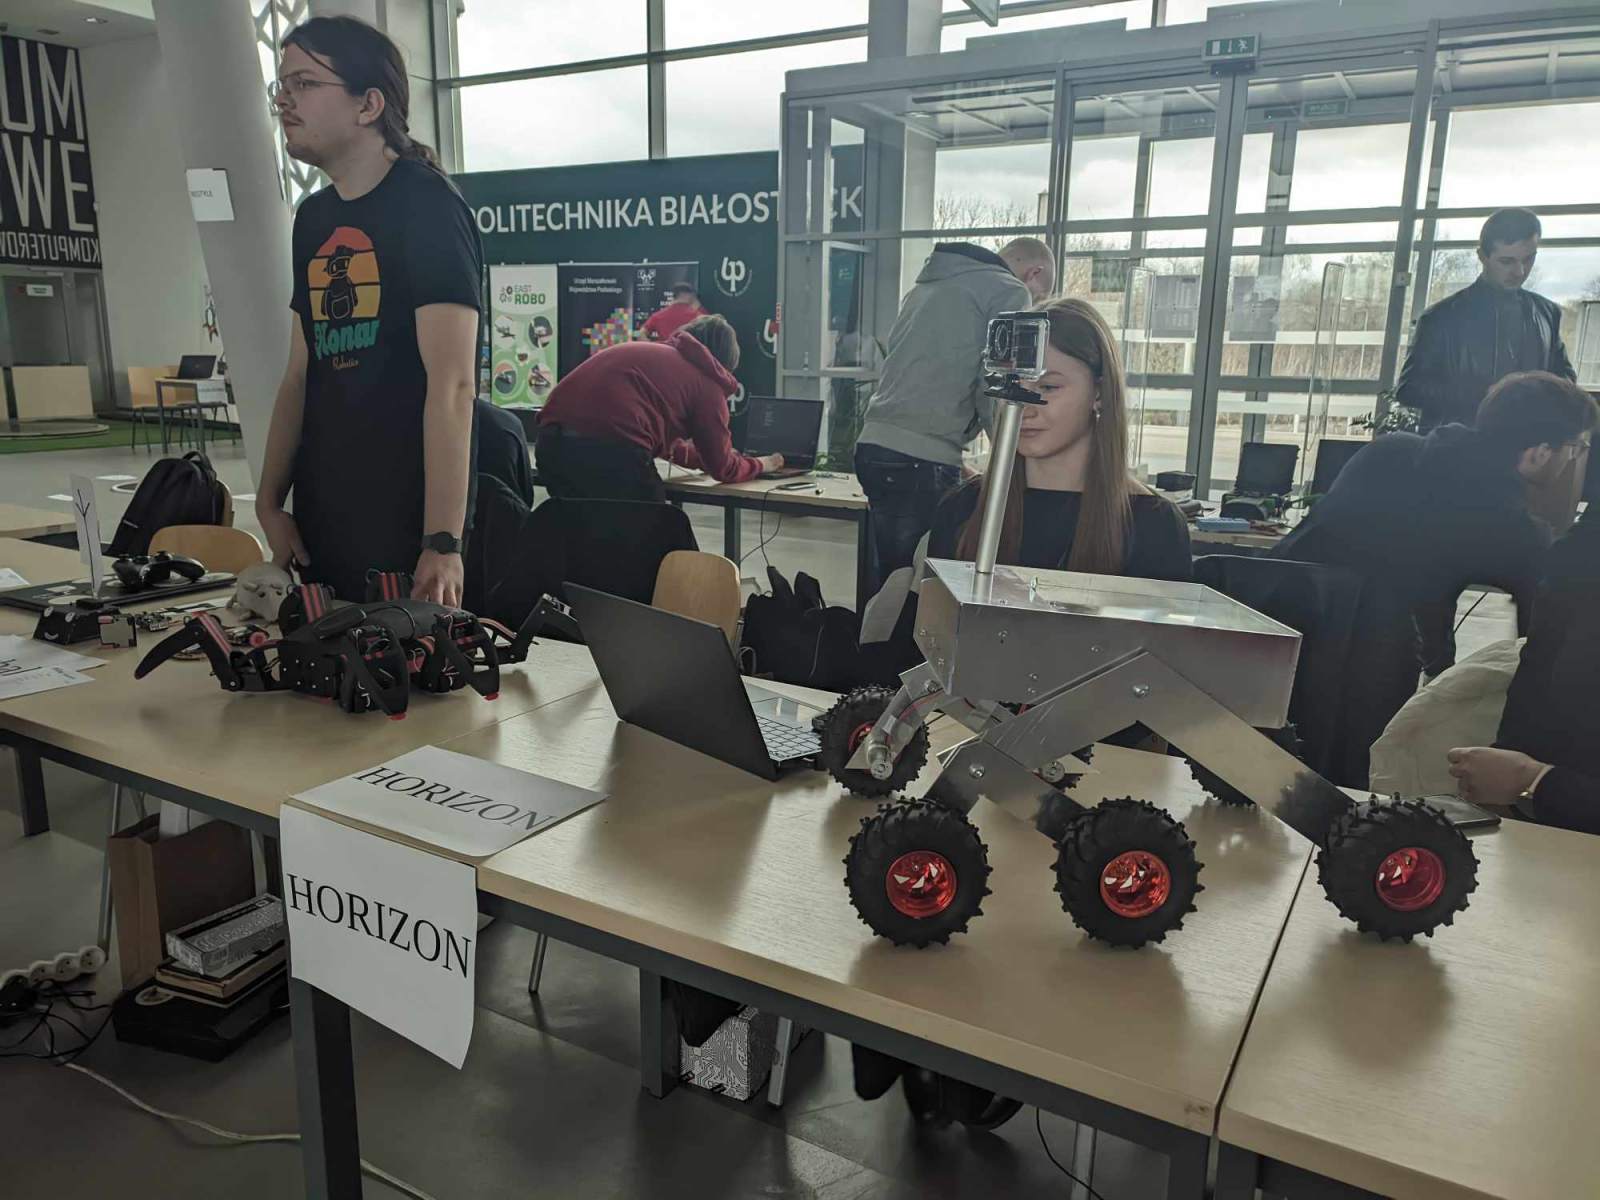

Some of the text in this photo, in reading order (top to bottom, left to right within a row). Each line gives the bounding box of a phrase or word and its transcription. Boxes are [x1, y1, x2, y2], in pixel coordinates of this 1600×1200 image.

[0, 132, 94, 232] WE
[514, 284, 532, 292] EAST
[514, 293, 546, 305] ROBO
[353, 766, 558, 831] HORIZON
[287, 872, 472, 979] HORIZON
